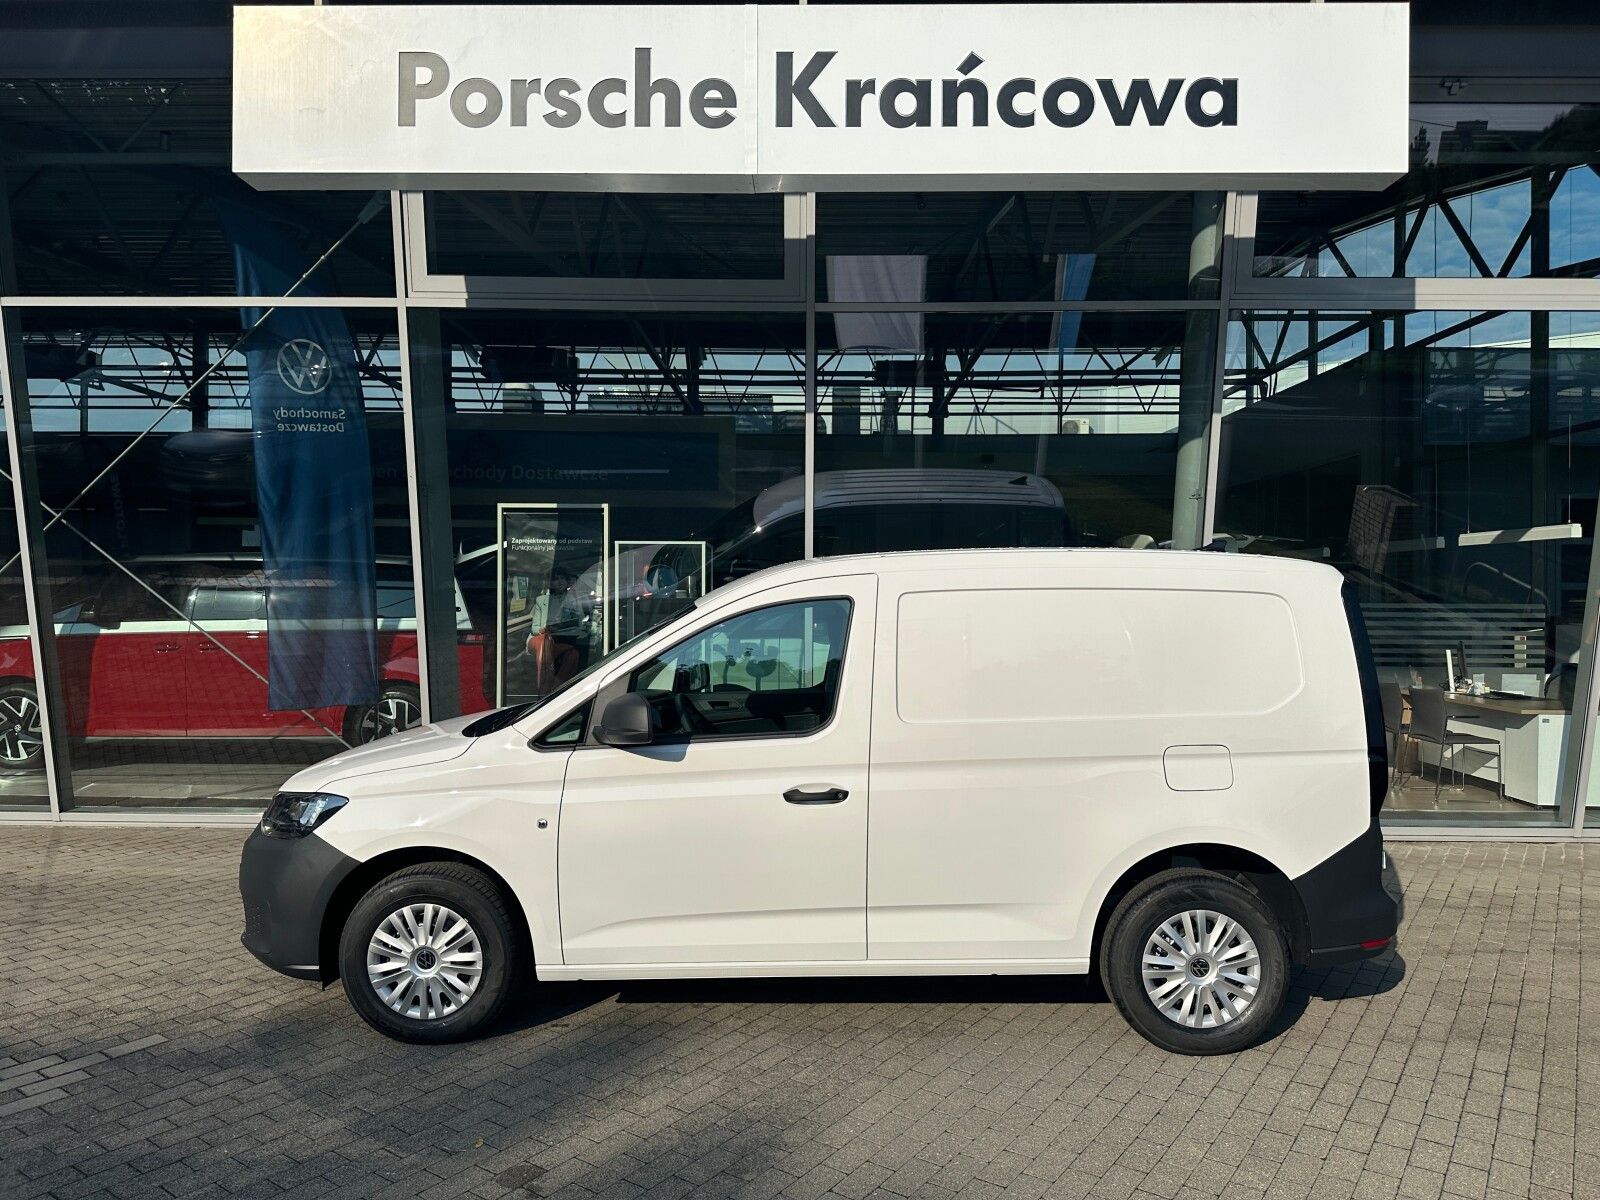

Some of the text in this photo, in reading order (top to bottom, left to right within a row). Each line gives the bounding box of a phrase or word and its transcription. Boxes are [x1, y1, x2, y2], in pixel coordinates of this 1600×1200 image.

[397, 47, 1239, 129] Porsche Krańcowa
[512, 464, 607, 481] Dostawcze
